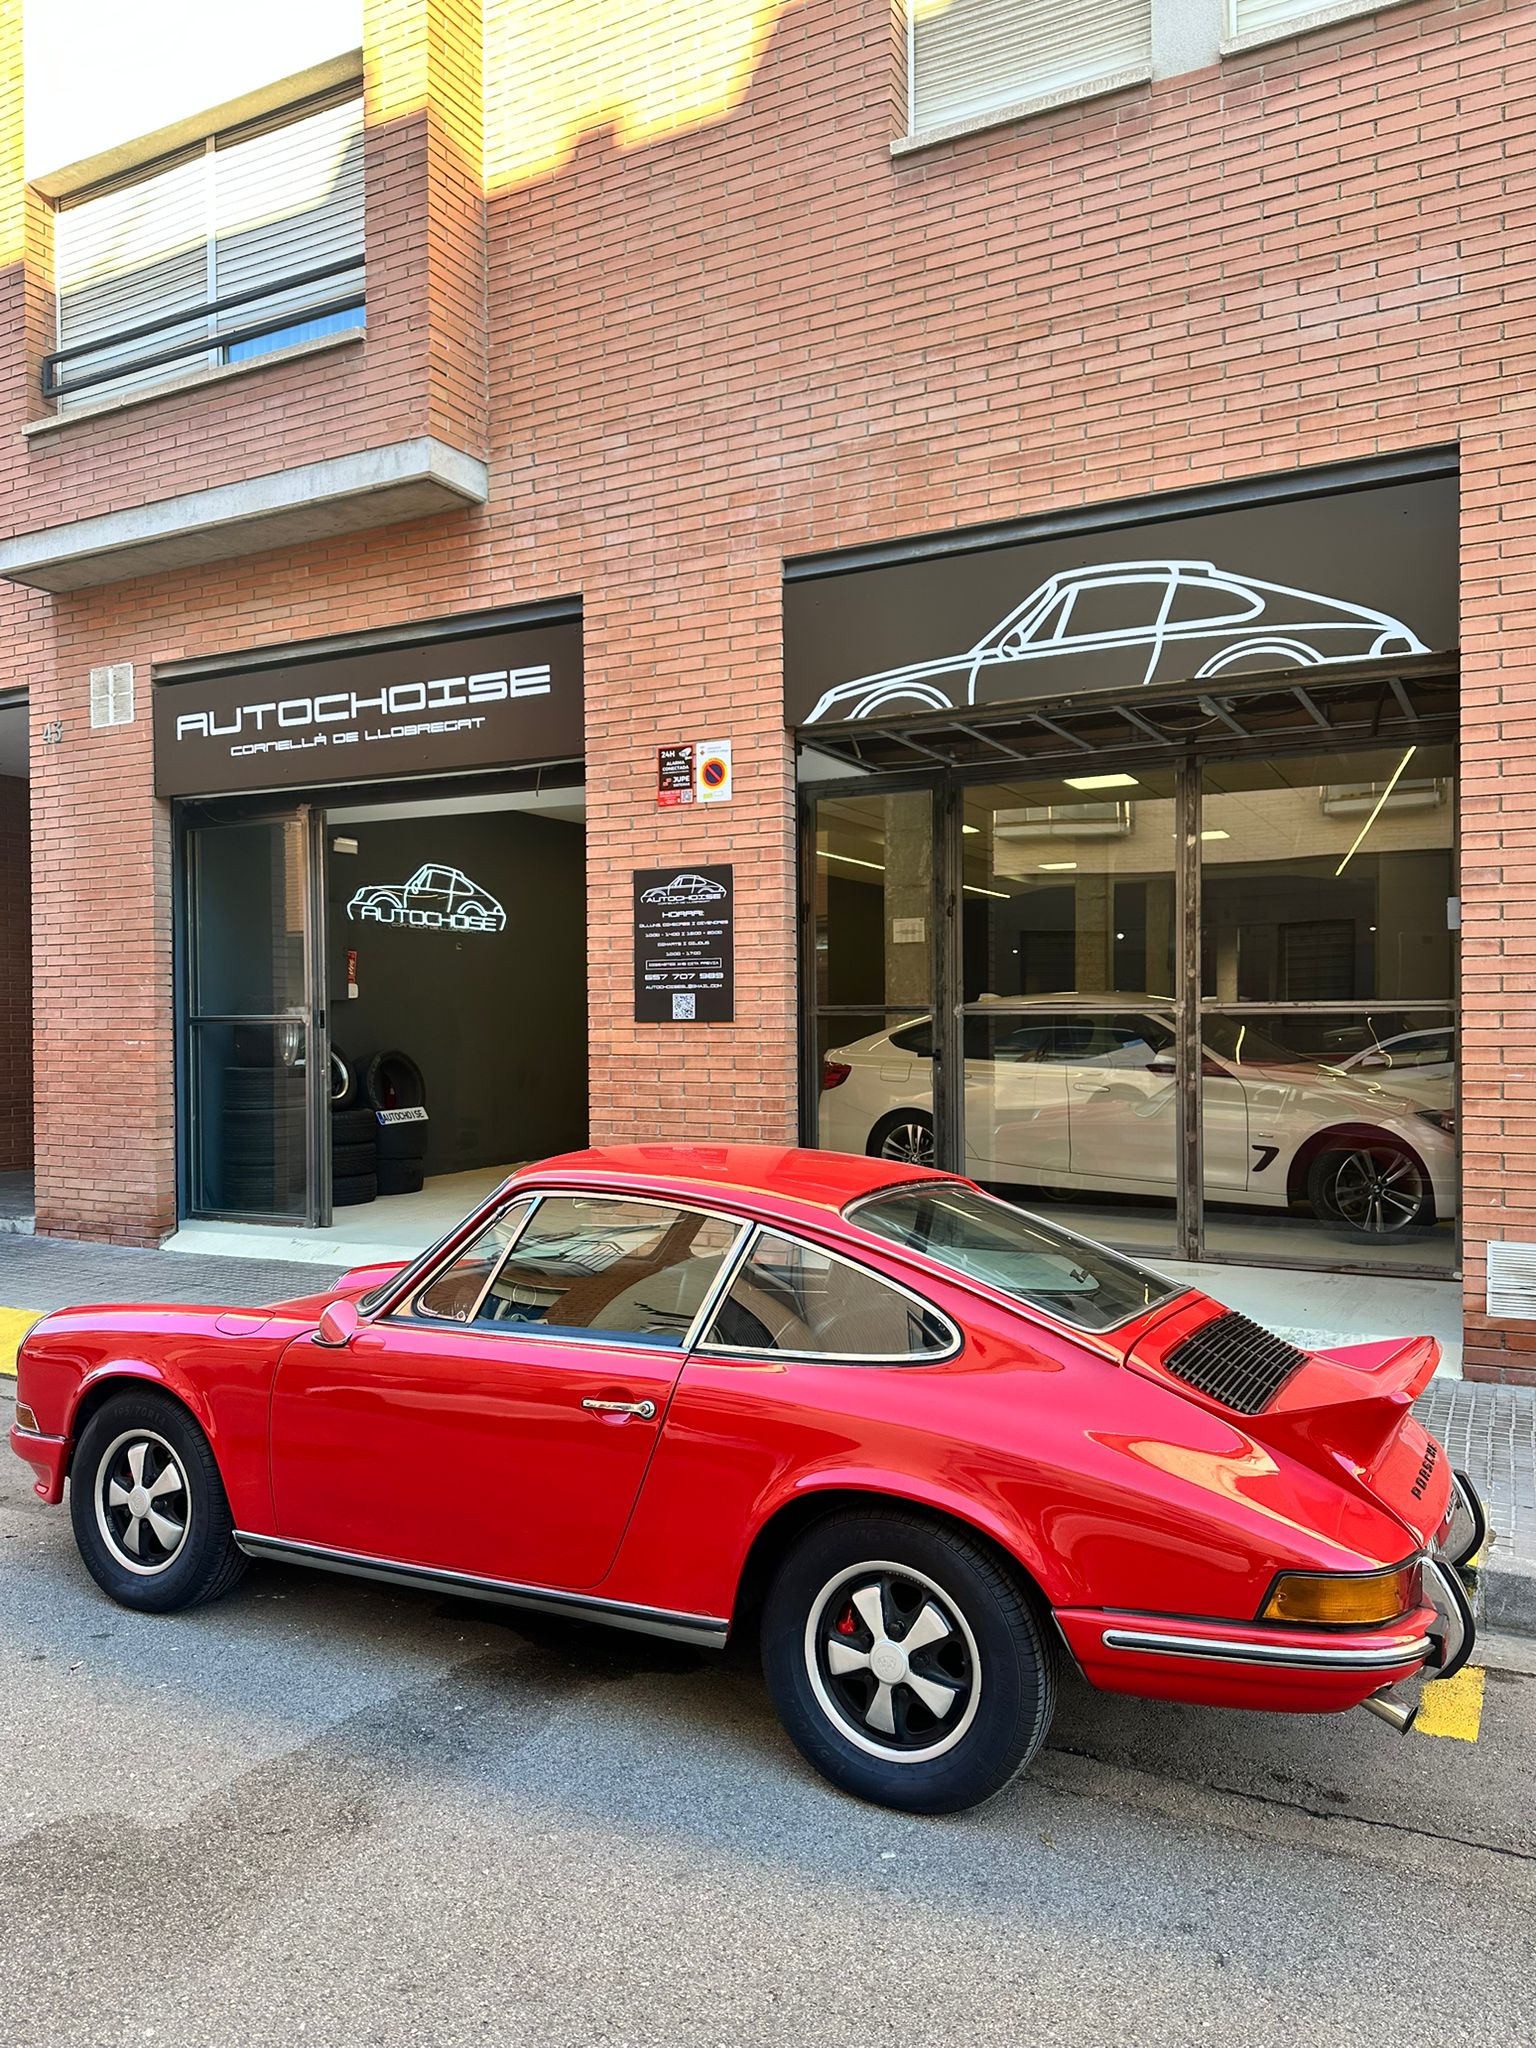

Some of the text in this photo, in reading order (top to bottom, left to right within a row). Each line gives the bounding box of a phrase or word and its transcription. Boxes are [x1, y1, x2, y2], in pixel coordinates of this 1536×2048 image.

[176, 664, 551, 741] AUTOCHOISE
[42, 720, 63, 744] 43
[230, 717, 486, 757] CORNELLÀ DE LLOBREGAT
[661, 750, 675, 758] 24H
[646, 893, 721, 903] AUTOCHOISE
[361, 906, 497, 932] AUTOCHOISE
[1410, 1441, 1438, 1501] PORSCHE
